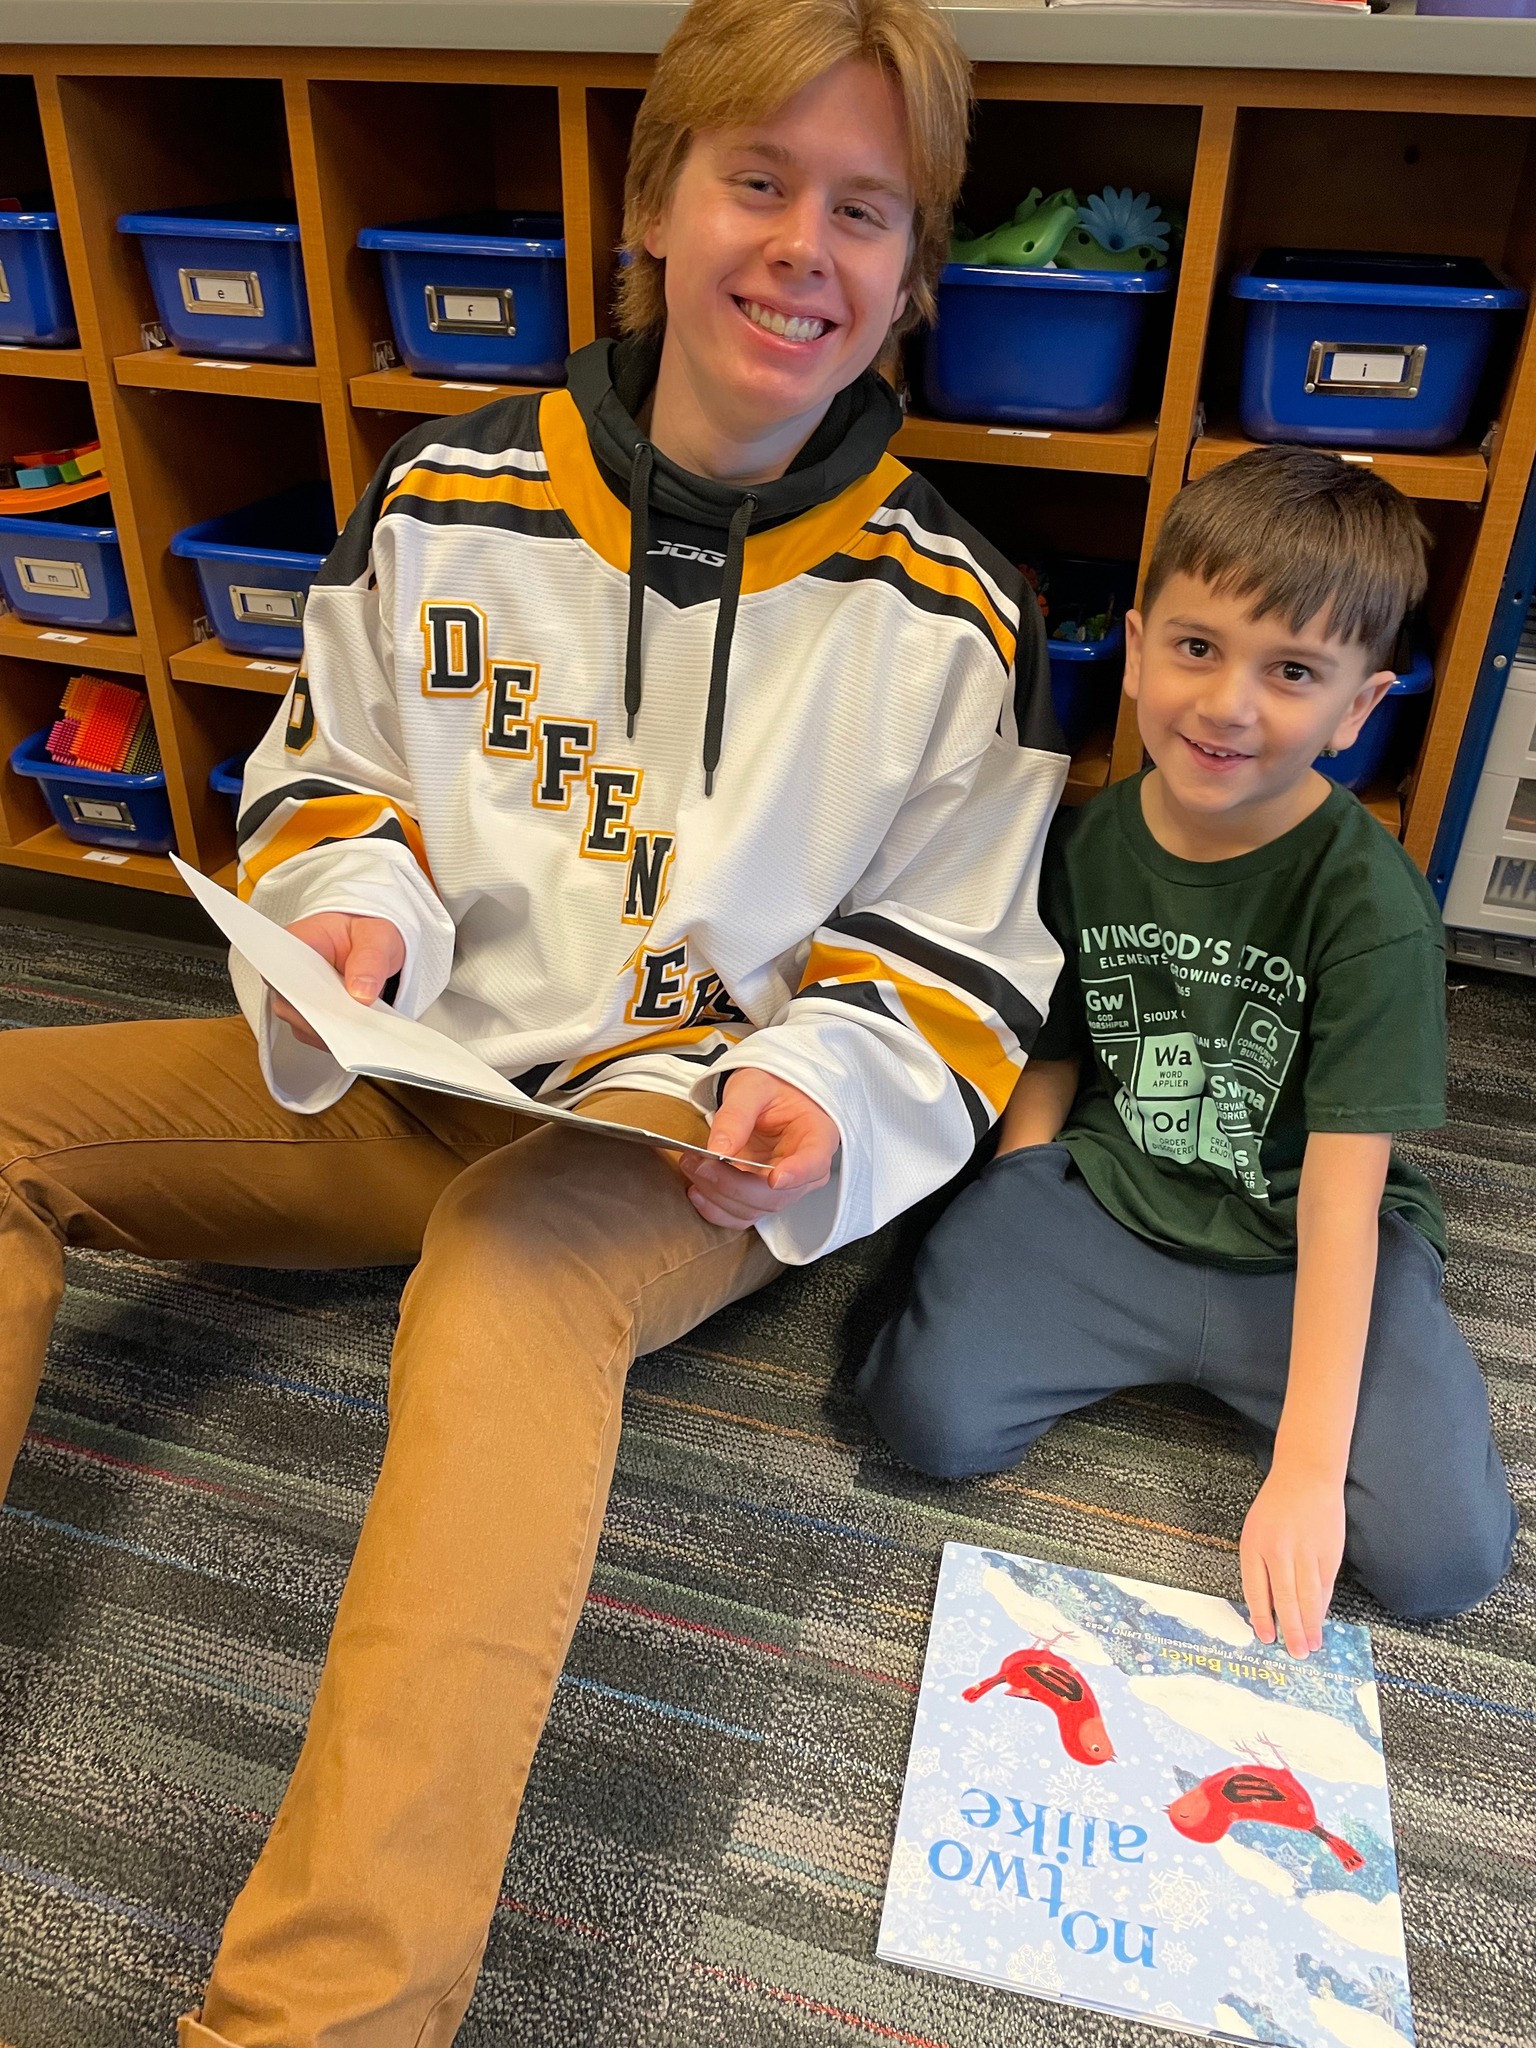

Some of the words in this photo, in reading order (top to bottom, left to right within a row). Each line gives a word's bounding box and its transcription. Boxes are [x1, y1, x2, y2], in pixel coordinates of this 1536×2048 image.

[216, 289, 226, 299] e
[467, 304, 474, 317] f
[1361, 363, 1368, 378] i
[646, 540, 727, 568] JOG
[47, 574, 59, 583] m
[265, 603, 273, 612] n
[419, 599, 755, 1030] DEFENERS
[1080, 922, 1161, 954] IVING
[1099, 952, 1168, 970] ELEMENTS
[1085, 989, 1124, 1012] Gw
[1097, 1014, 1114, 1023] GOD
[1143, 1010, 1178, 1023] SIOUX
[1250, 1019, 1279, 1052] Cb
[1155, 1044, 1193, 1067] Wa
[1237, 1038, 1279, 1067] COMMUNITY
[1239, 1047, 1272, 1071] BUILDER
[1159, 1070, 1183, 1079] WORD
[1152, 1079, 1189, 1088] APPLIER
[1152, 1109, 1190, 1133] Od
[1159, 1137, 1187, 1147] ORDER
[1085, 1622, 1109, 1633] Peas
[1112, 1628, 1142, 1639] LMNO
[1145, 1632, 1200, 1652] bestselling
[1201, 1644, 1233, 1659] Times
[1158, 1647, 1222, 1672] Baker
[1236, 1653, 1260, 1666] York
[1263, 1660, 1287, 1671] New
[1228, 1661, 1286, 1686] Keith
[1289, 1664, 1308, 1674] the
[1323, 1671, 1363, 1686] Creator
[960, 1788, 1148, 1868] alike
[927, 1839, 1066, 1919] two
[1061, 1910, 1158, 1970] no
